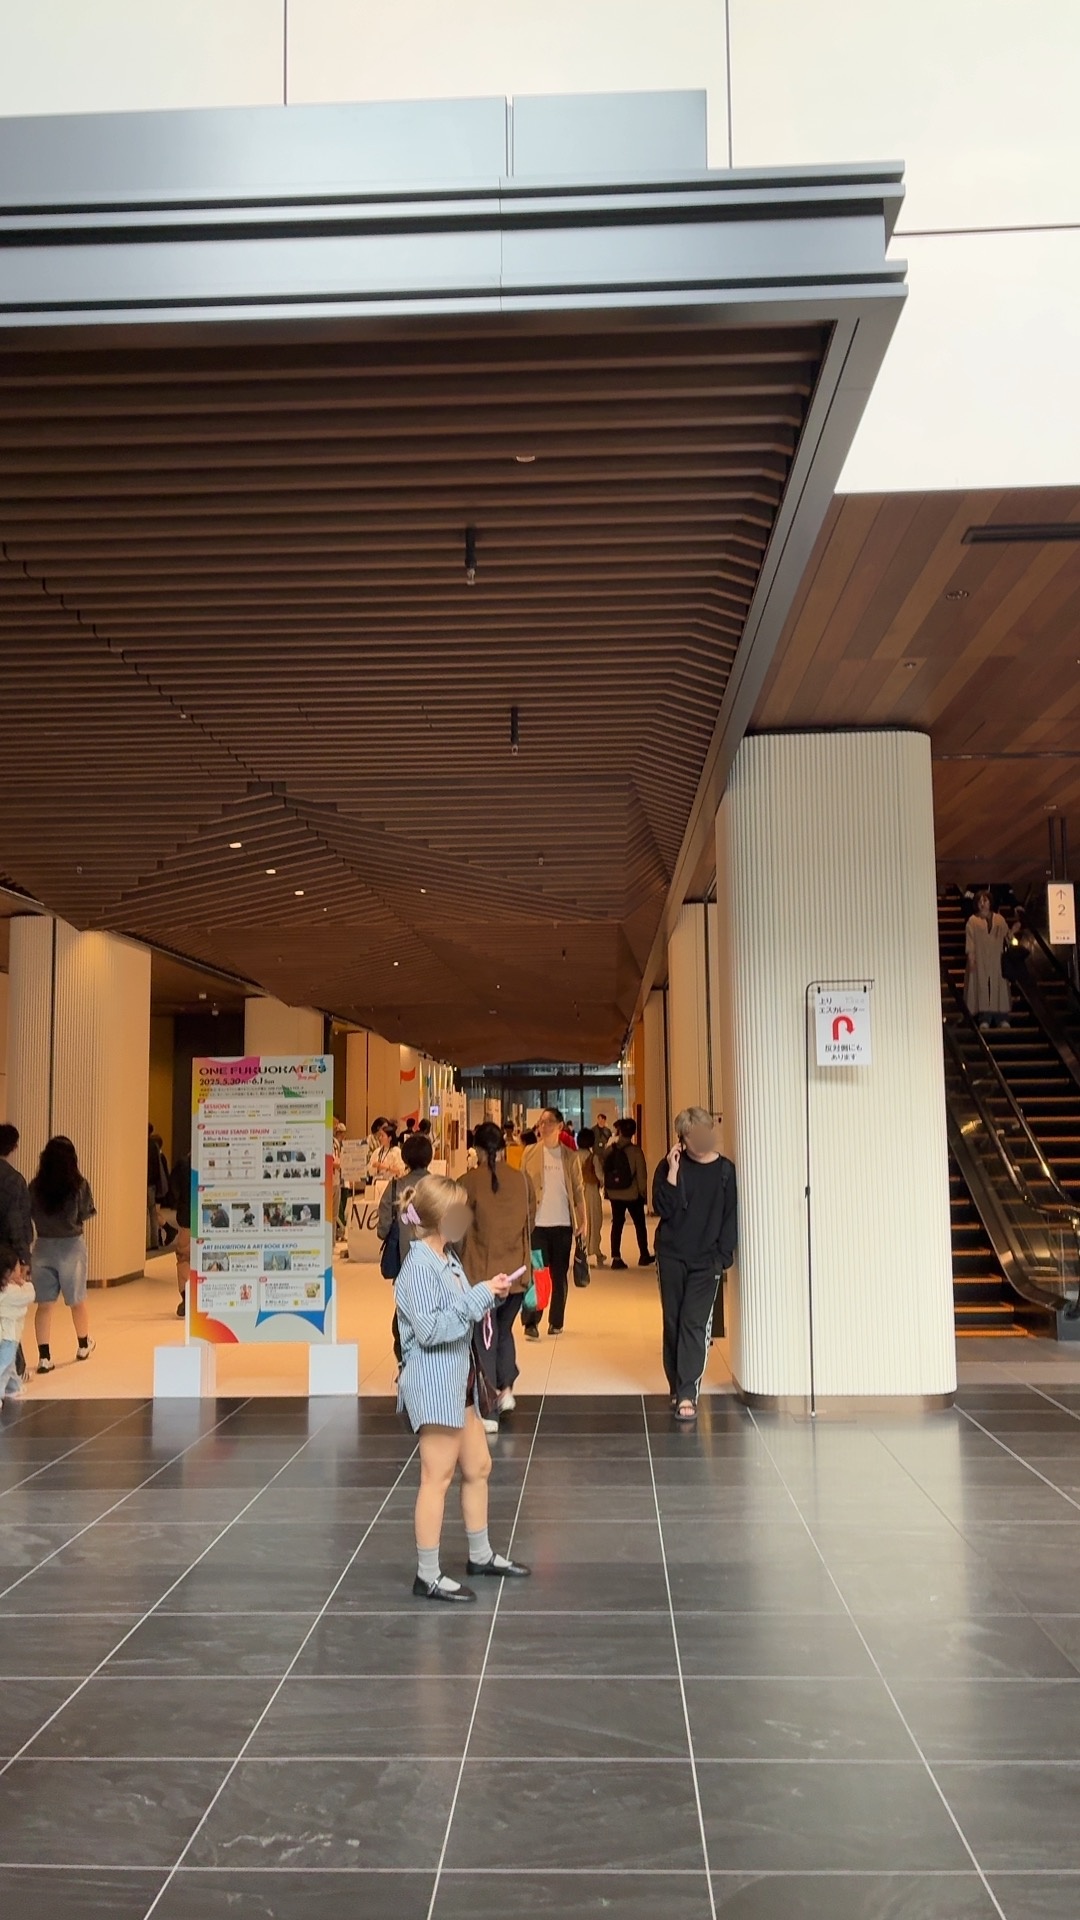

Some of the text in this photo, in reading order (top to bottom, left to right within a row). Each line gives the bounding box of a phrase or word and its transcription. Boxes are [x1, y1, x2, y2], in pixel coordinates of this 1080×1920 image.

[1058, 904, 1066, 916] 2
[825, 1044, 862, 1052] 反対側にも
[199, 1066, 228, 1076] ONE
[300, 1064, 327, 1074] FES
[350, 1204, 378, 1230] Ne
